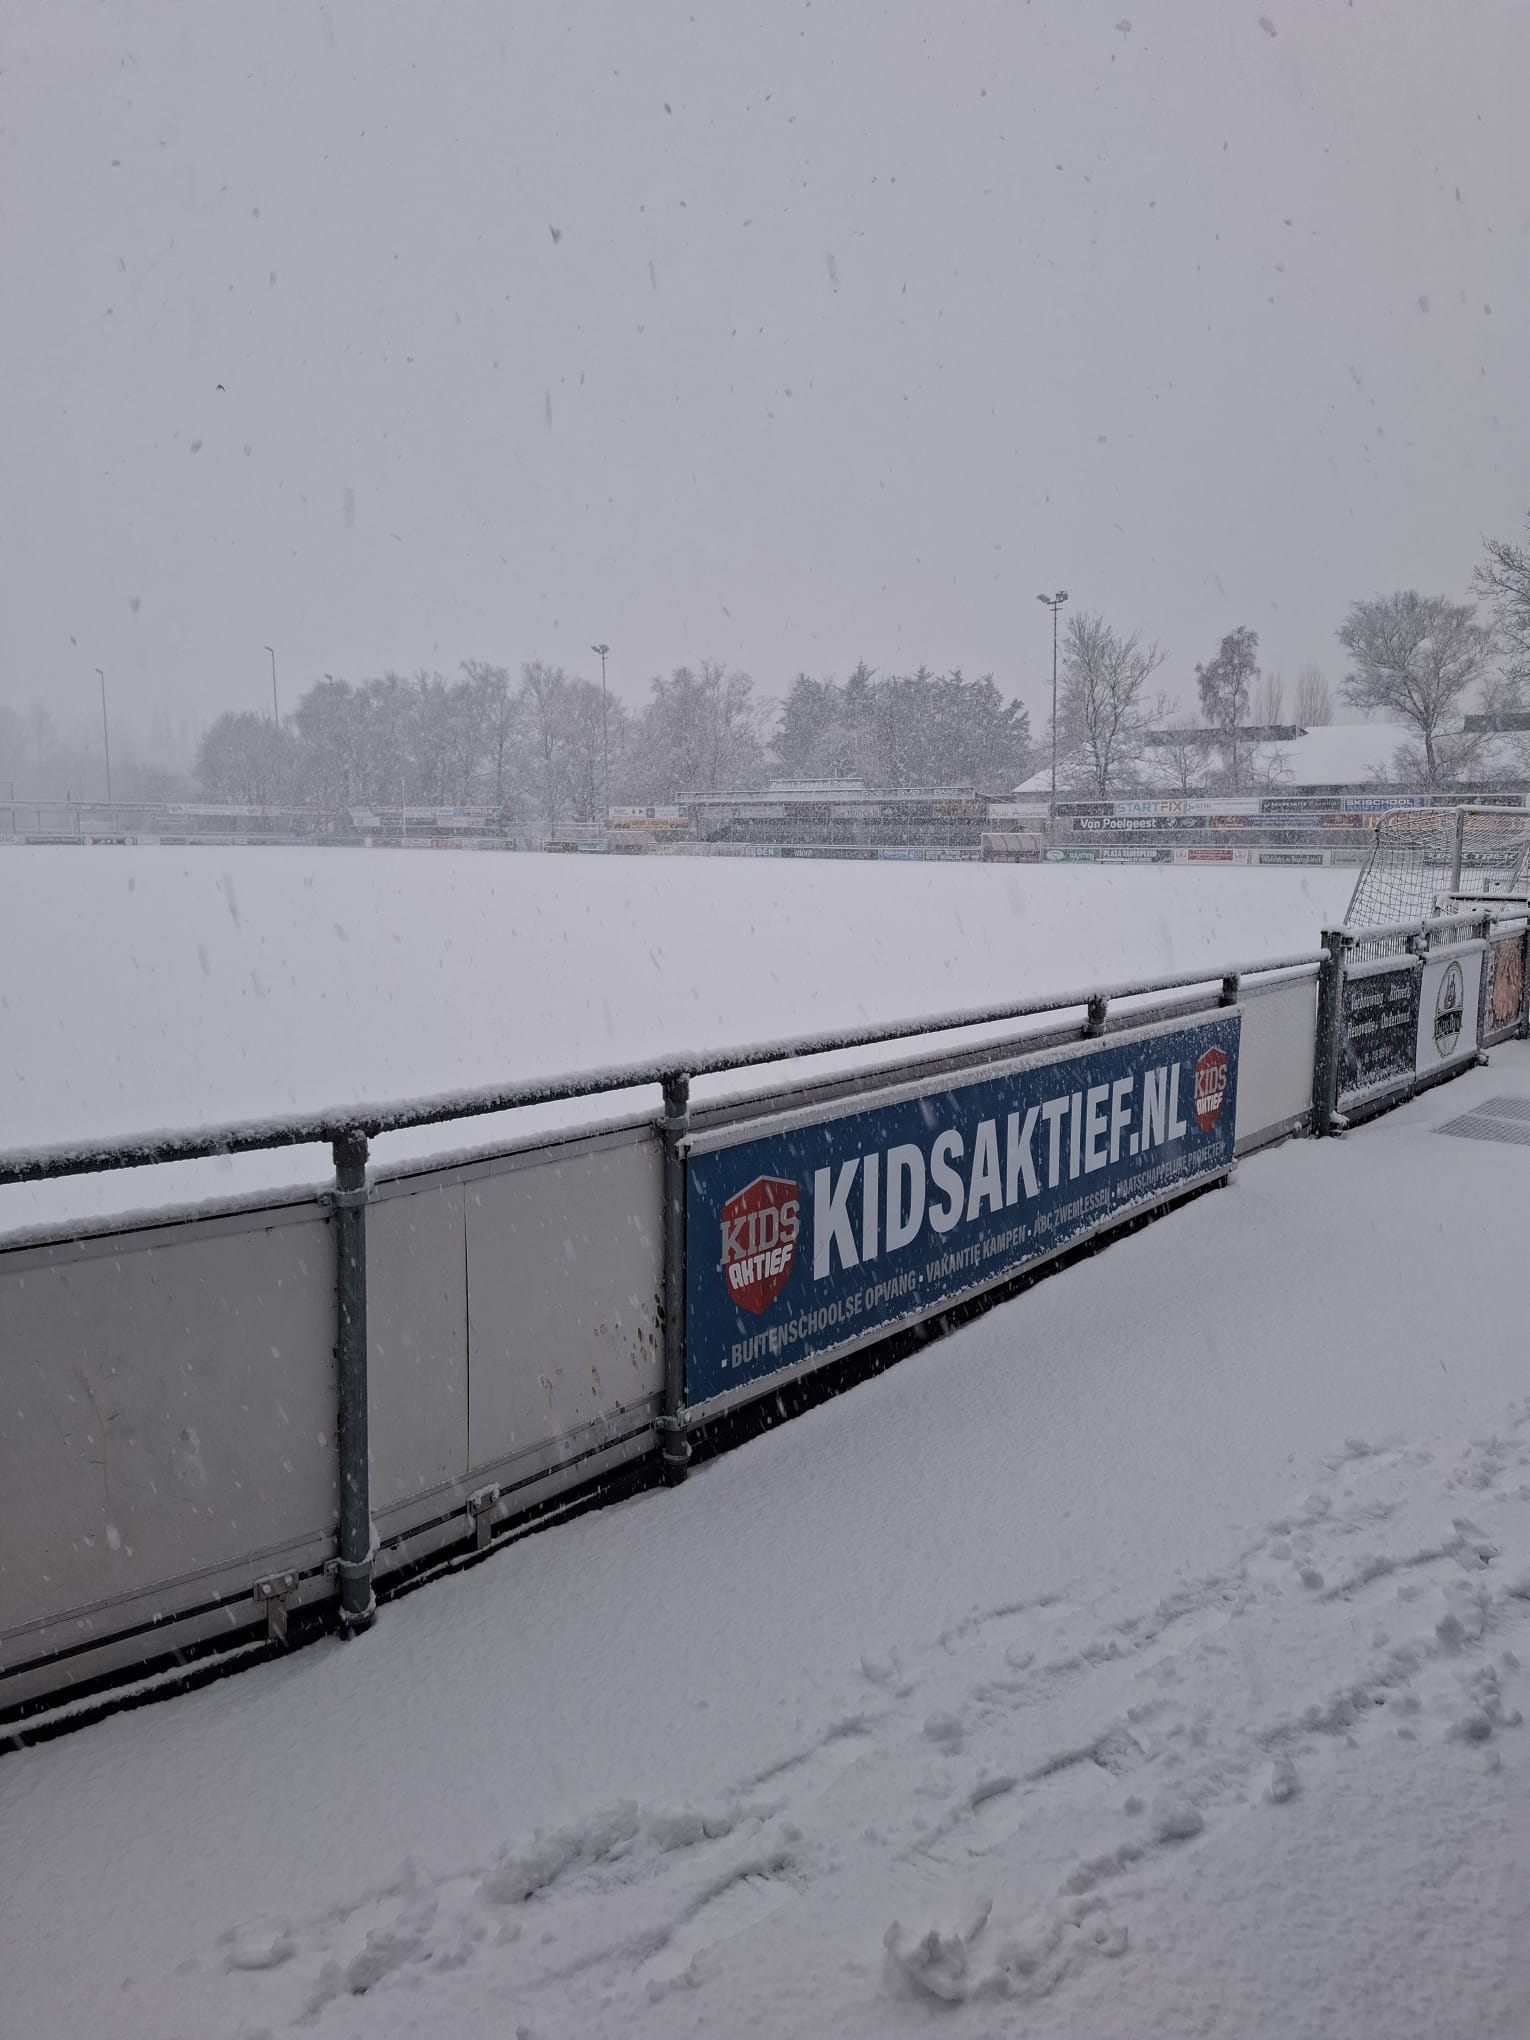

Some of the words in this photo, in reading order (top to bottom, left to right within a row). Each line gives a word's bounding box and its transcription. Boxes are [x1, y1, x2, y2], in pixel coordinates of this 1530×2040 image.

[1080, 818, 1100, 829] Van
[1103, 818, 1157, 831] Poelgeest
[1116, 800, 1183, 812] STARTFIX
[1194, 1063, 1227, 1099] KIDS
[1196, 1091, 1223, 1116] AKTIEF
[813, 1062, 1188, 1281] KIDSAKTIEF.NL
[720, 1200, 800, 1265] KIDS
[728, 1244, 793, 1290] AKTIEF
[731, 1295, 863, 1369] BUITENSCHOOLSE
[865, 1271, 916, 1310] OPVANG
[926, 1241, 981, 1283] VAKANTIE
[983, 1225, 1026, 1257] KAMPEN
[1033, 1217, 1053, 1236] ABC
[1054, 1188, 1111, 1225] ZWEMLESSEN
[1117, 1156, 1186, 1198] MAATSCHAPPELIJKE
[1188, 1142, 1225, 1169] PROJECTEN
